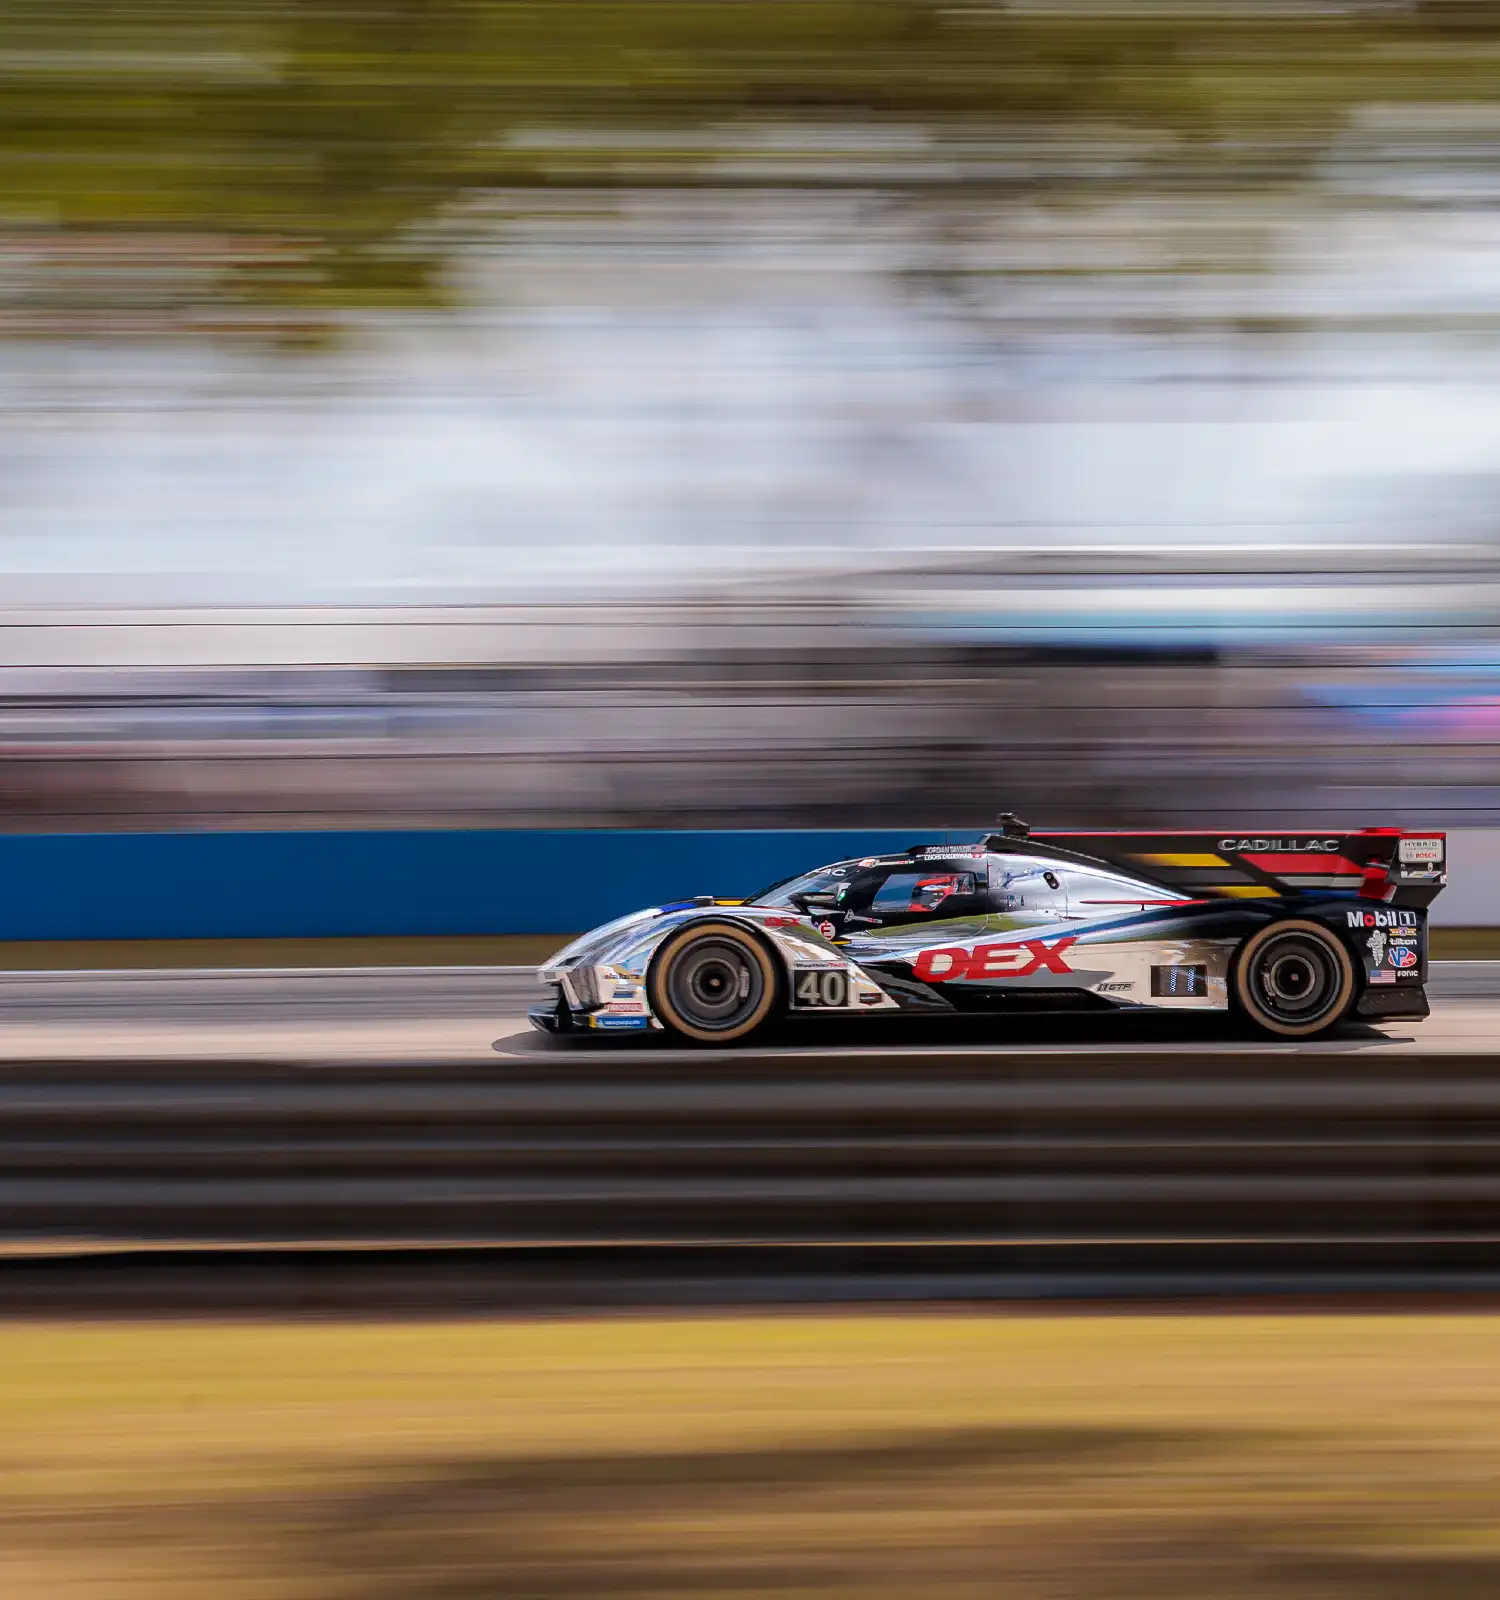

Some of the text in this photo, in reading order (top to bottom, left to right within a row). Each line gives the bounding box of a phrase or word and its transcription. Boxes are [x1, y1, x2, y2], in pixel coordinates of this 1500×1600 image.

[1218, 839, 1339, 851] CADILLAC
[1346, 911, 1413, 927] Mobil 1
[912, 937, 1079, 983] DEX
[1389, 947, 1408, 967] VP
[797, 971, 845, 1006] 40
